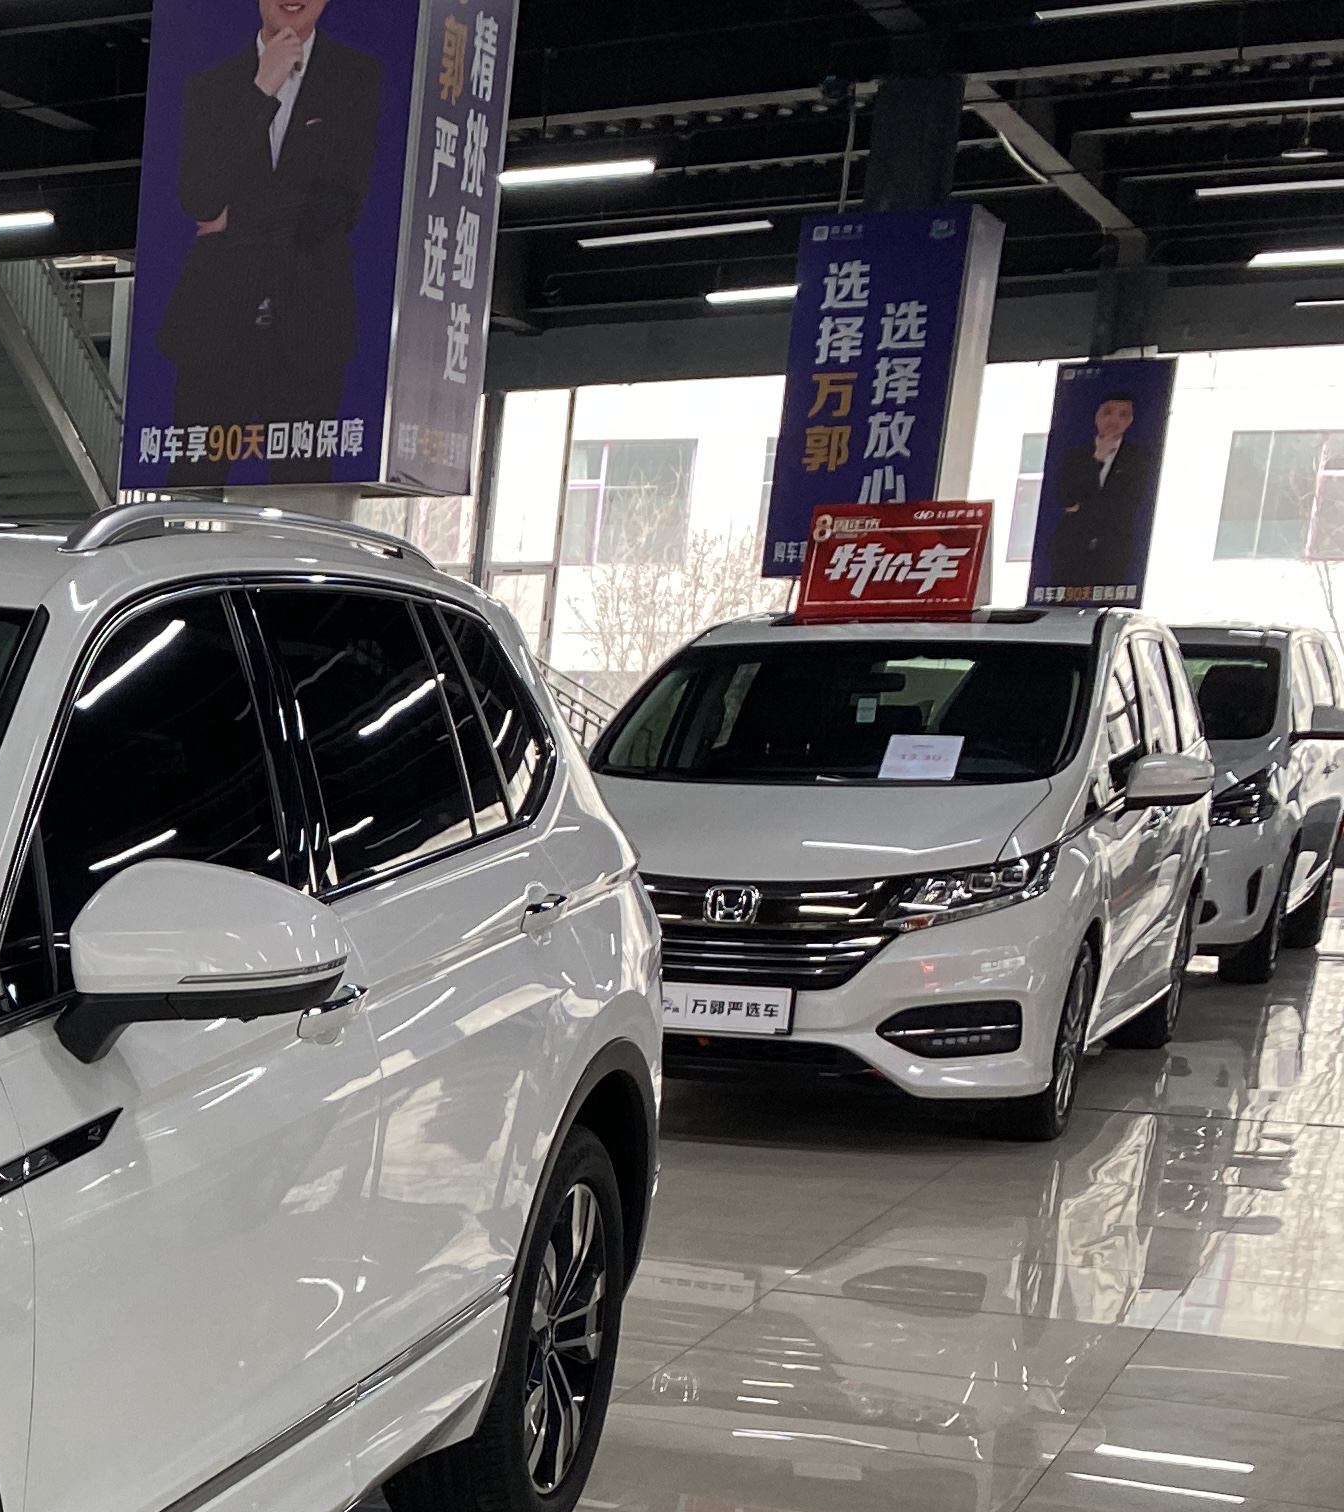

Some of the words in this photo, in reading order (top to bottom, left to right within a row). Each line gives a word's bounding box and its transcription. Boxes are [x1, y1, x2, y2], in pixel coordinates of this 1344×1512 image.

[443, 10, 499, 384] 精挑细选
[801, 259, 871, 473] 选择万郭
[857, 299, 928, 504] 选择放心
[138, 418, 365, 464] 购车享90天回购保障
[824, 543, 971, 599] 特价车
[691, 999, 779, 1018] 万郭严选车
